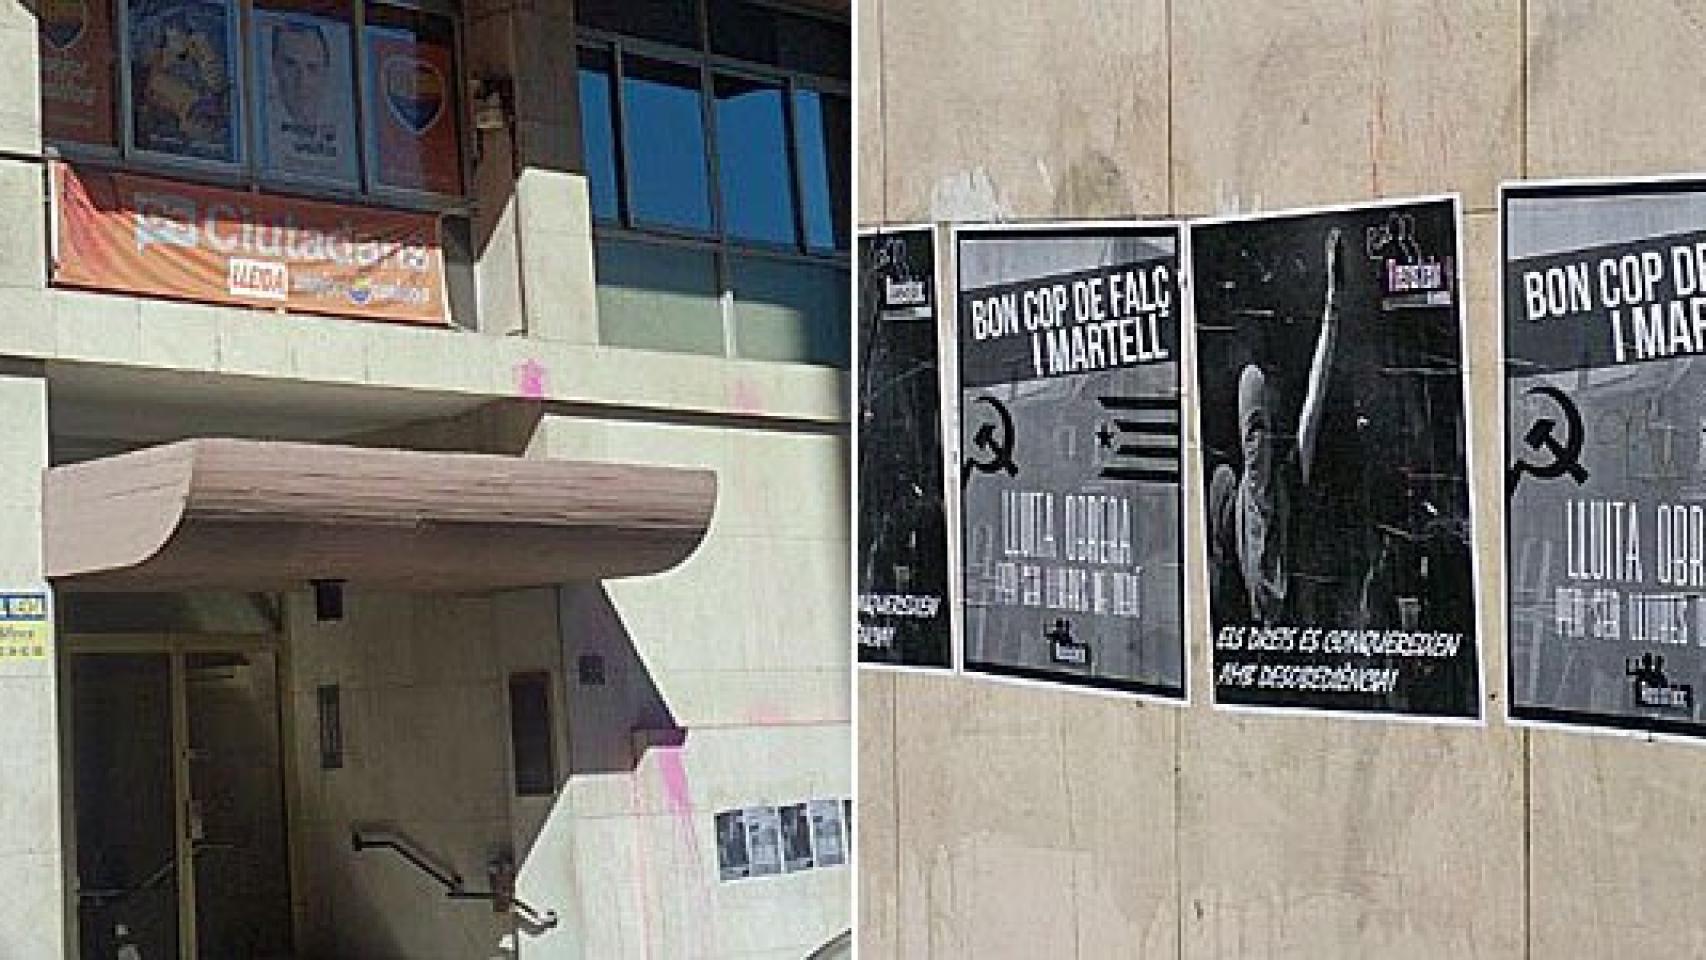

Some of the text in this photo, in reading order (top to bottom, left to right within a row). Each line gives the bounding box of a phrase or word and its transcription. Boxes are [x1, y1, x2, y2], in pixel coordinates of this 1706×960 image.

[972, 265, 1169, 340] BON COP DE FALÇ
[1523, 262, 1592, 320] BON
[1599, 252, 1662, 308] COP
[1033, 313, 1169, 376] I MARTELL
[1612, 309, 1626, 363] I
[1001, 489, 1057, 558] LLUITA
[1567, 499, 1643, 583] LLUITA
